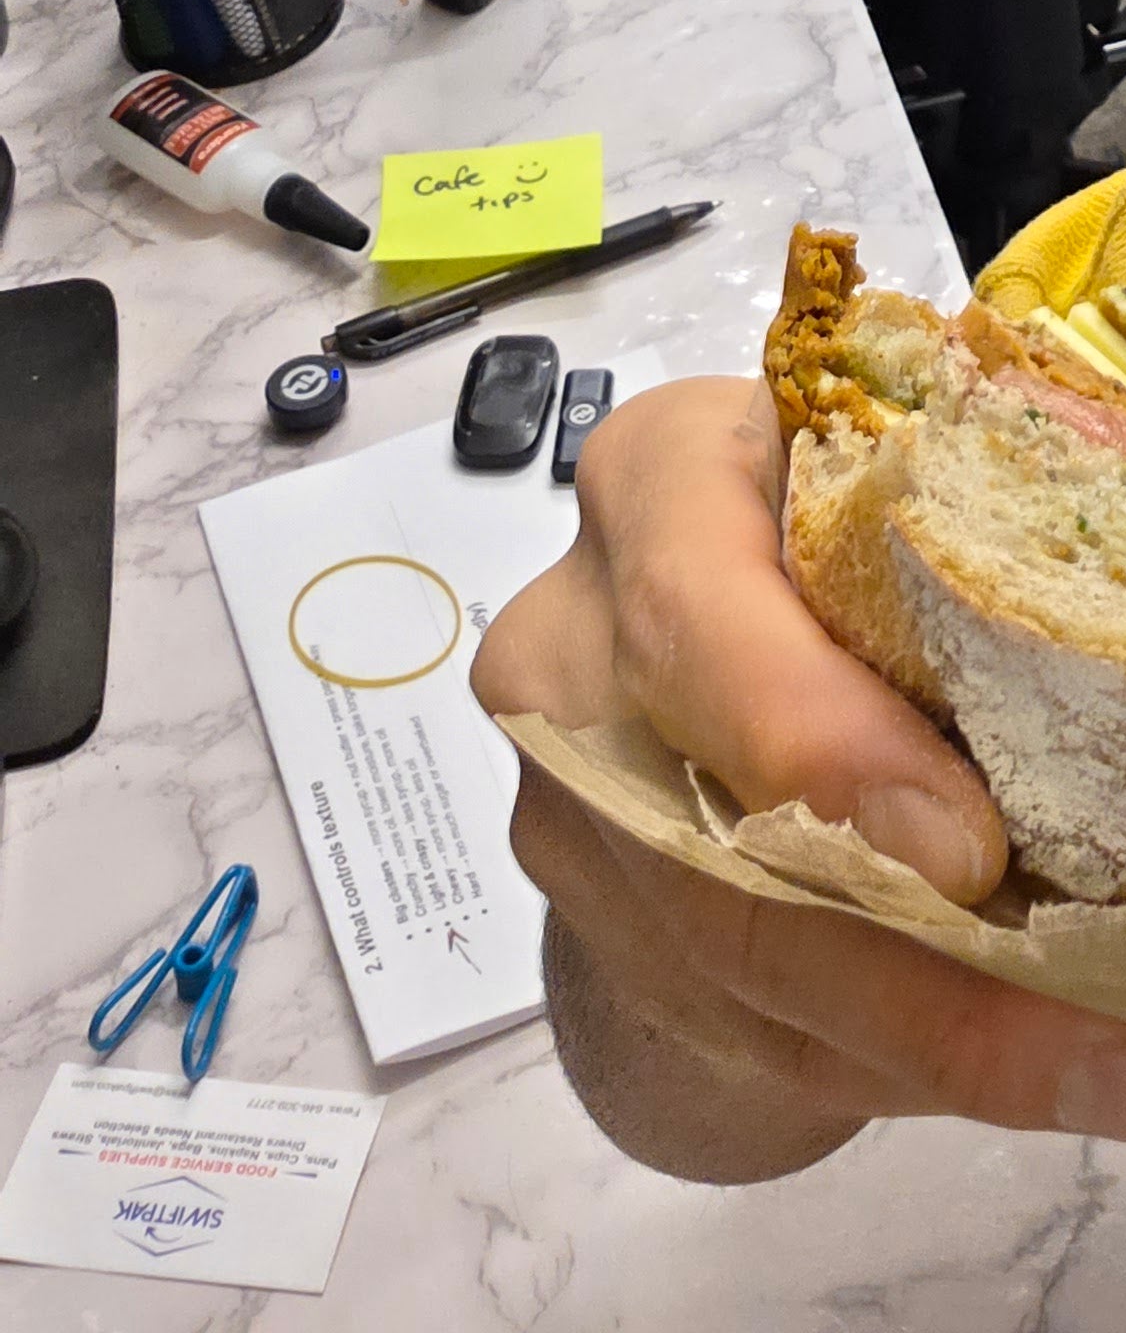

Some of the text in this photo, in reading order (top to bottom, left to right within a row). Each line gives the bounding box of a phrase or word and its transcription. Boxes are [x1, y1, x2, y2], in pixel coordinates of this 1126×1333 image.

[414, 165, 485, 196] Cafe
[470, 191, 535, 212] tips
[327, 698, 343, 723] press
[352, 714, 366, 737] bake
[374, 728, 387, 740] oil
[338, 734, 354, 762] butter
[381, 742, 397, 767] more
[404, 757, 418, 771] oil
[412, 772, 425, 795] less
[357, 789, 374, 818] syrup
[375, 786, 391, 814] lower
[401, 802, 415, 824] less
[409, 716, 482, 899] Hard too much sugar or overbaked
[367, 820, 382, 846] more
[391, 831, 406, 857] more
[430, 827, 446, 854] more
[414, 839, 431, 870] crispy
[311, 781, 383, 975] 2. What controls texture
[381, 860, 402, 903] clusters
[424, 872, 435, 881] &
[446, 869, 464, 904] Chewy
[405, 872, 427, 917] Crunchy
[428, 882, 446, 911] Light
[396, 904, 409, 924] Big
[52, 1131, 94, 1144] Straws
[94, 1121, 306, 1152] Divers Restaurant Needs Selection
[99, 1149, 277, 1178] FOOD SERVICE SUPPLIES
[265, 1151, 299, 1165] Cups,
[305, 1154, 338, 1169] Pans,
[114, 1200, 224, 1230] SWIFTPAK
